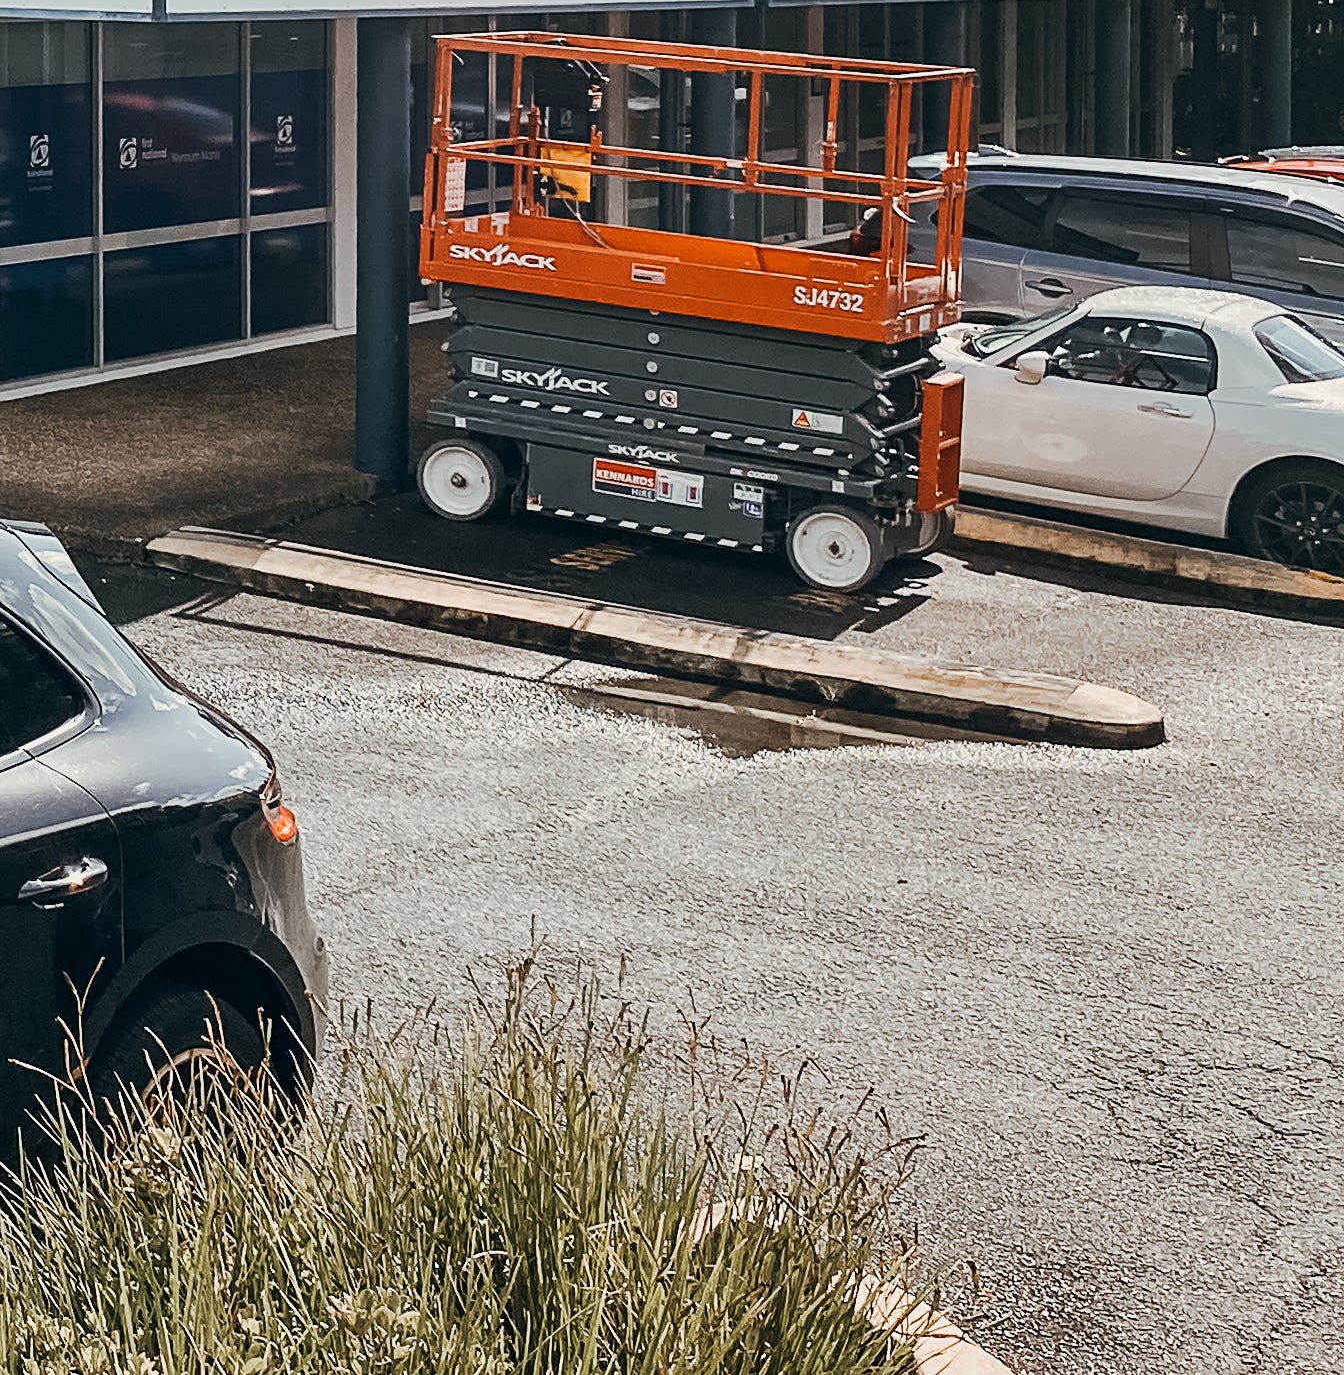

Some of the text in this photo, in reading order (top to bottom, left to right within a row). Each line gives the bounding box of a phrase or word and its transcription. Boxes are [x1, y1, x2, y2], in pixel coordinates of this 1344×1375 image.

[448, 244, 557, 271] SKYJACK
[793, 285, 865, 313] SJ4732
[501, 367, 611, 396] SKYJACK
[607, 443, 681, 464] SKYJACK
[596, 468, 656, 488] KENNARDS
